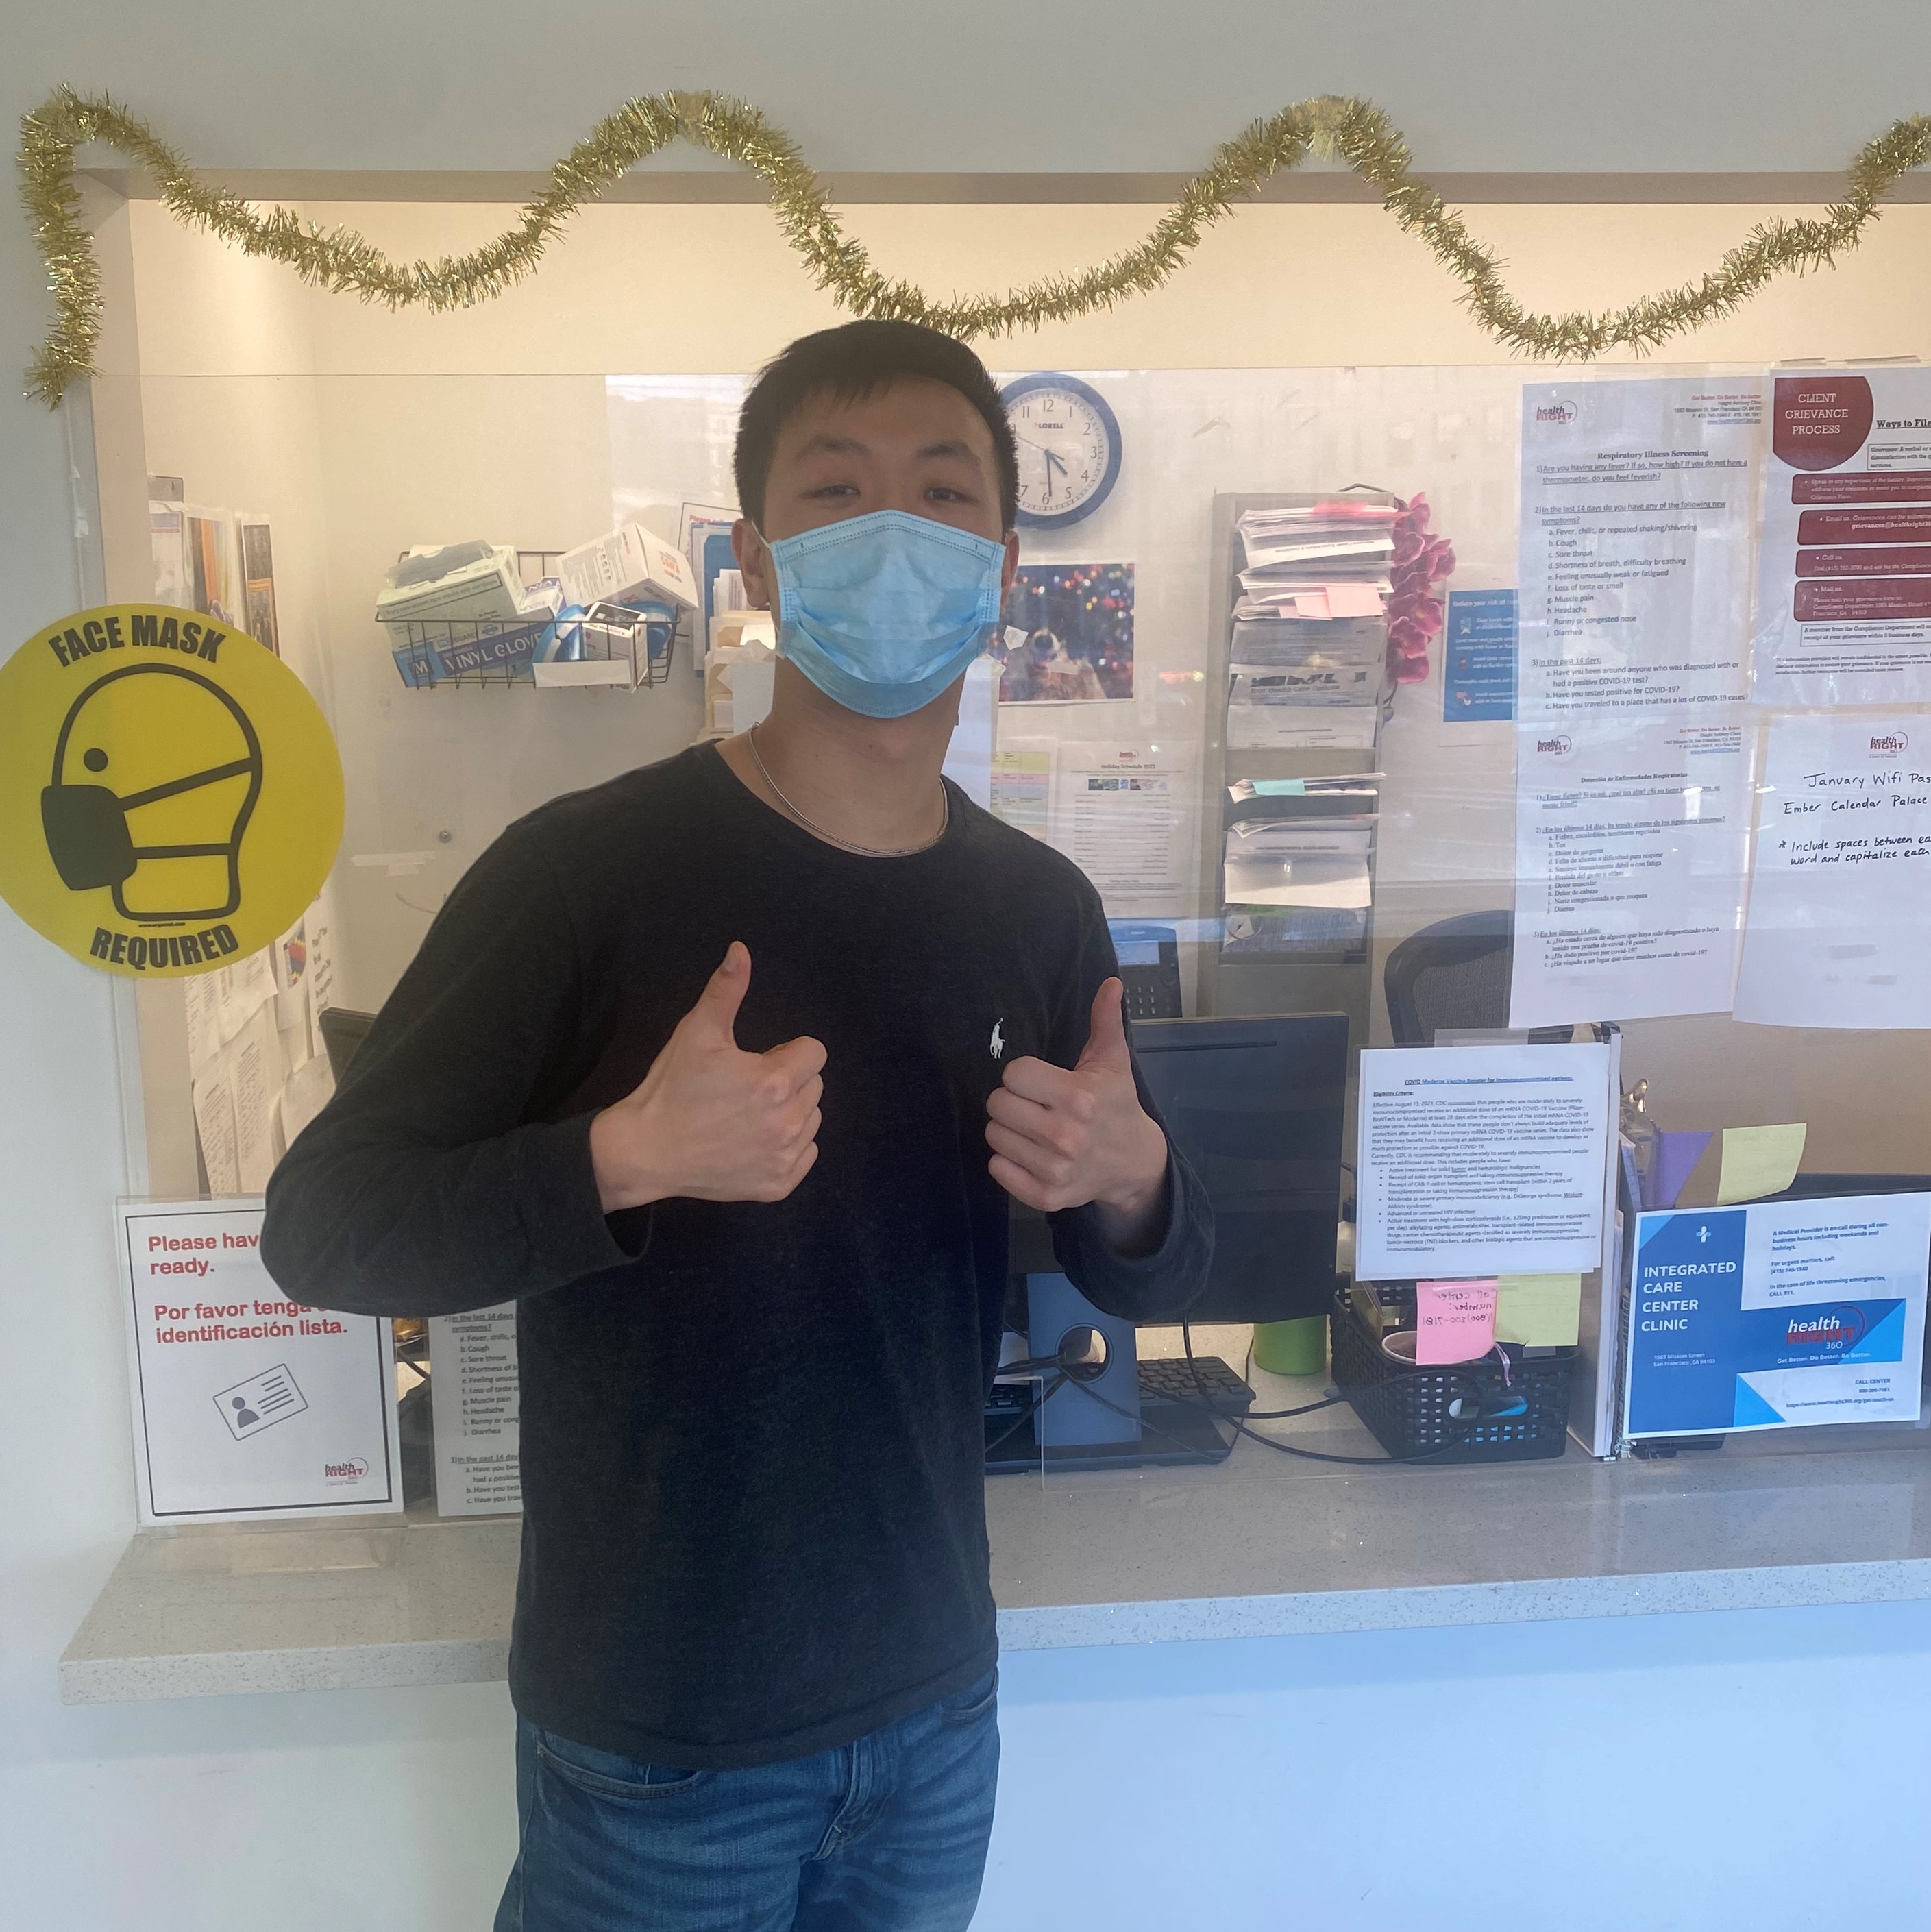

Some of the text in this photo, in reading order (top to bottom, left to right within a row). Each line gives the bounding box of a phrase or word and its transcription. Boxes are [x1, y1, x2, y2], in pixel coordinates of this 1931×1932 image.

[1798, 393, 1836, 403] CLIENT
[1043, 399, 1054, 412] 12
[1069, 406, 1072, 417] 1
[1537, 406, 1565, 415] health
[1022, 406, 1030, 418] 11
[1785, 409, 1848, 419] GRIEVANCE
[1083, 423, 1091, 435] 2
[1792, 425, 1841, 435] PROCESS
[1876, 419, 1901, 429] Ways
[1915, 419, 1931, 427] File
[1091, 446, 1097, 458] 3
[1597, 452, 1643, 461] Respiratory
[1081, 470, 1089, 482] 4
[1021, 485, 1028, 497] 7
[1065, 487, 1072, 499] 5
[1042, 493, 1050, 504] 6
[1607, 526, 1637, 535] repeated
[1639, 524, 1697, 533] shaking/shivering
[1556, 539, 1577, 548] Cough
[1598, 559, 1622, 567] breath,
[1623, 558, 1652, 567] difficulty
[1555, 606, 1586, 614] Headache
[49, 615, 227, 668] FACE MASK
[495, 632, 543, 657] GLOVE
[1684, 663, 1715, 672] diagnosed
[1573, 678, 1597, 687] positive
[1599, 676, 1630, 685] COVID-19
[1585, 689, 1604, 697] tested
[1606, 688, 1632, 696] positive
[1645, 685, 1680, 694] COVID-19?
[1871, 737, 1896, 745] health
[1804, 770, 1931, 789] January Wifi Pas
[1784, 795, 1928, 814] Ember Calendar Palace
[1792, 840, 1829, 852] Include
[1834, 839, 1868, 851] spaces
[1874, 836, 1912, 846] between
[1791, 853, 1817, 865] word
[1821, 854, 1841, 863] and
[1845, 847, 1898, 864] capitalize
[89, 924, 238, 970] REQUIRED
[148, 1233, 258, 1252] Please hav
[150, 1259, 214, 1277] ready.
[1645, 1262, 1736, 1278] INTEGRATED
[1643, 1282, 1682, 1294] CARE
[154, 1299, 312, 1321] Por favor tenga
[1643, 1299, 1699, 1313] CENTER
[1641, 1319, 1688, 1332] CLINIC
[1788, 1315, 1840, 1333] health
[156, 1318, 347, 1344] identificación lista.
[1786, 1327, 1856, 1345] RIGHT
[1825, 1341, 1843, 1349] 360
